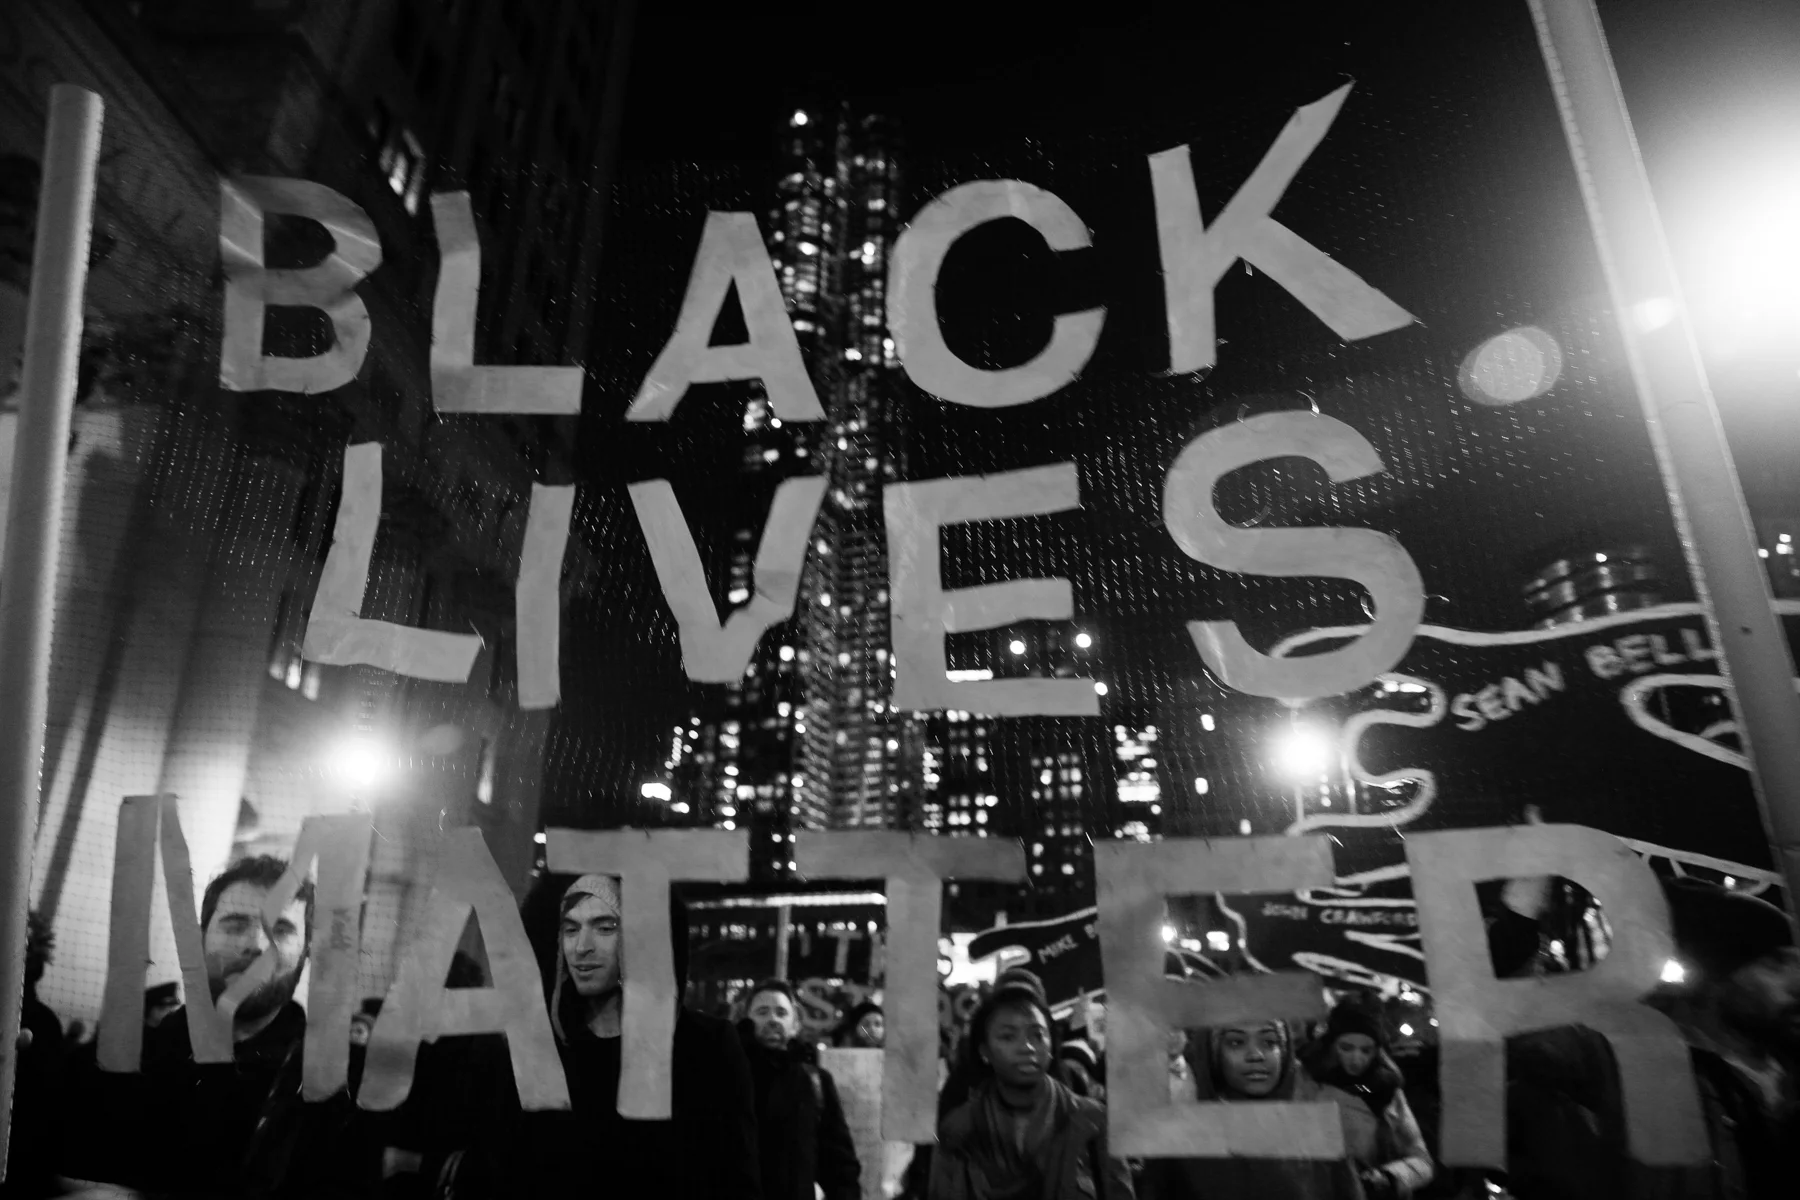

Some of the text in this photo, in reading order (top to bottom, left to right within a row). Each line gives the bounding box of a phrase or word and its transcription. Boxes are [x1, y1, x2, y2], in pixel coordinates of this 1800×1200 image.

[218, 81, 1415, 421] BLACK
[301, 409, 1426, 717] LIVES
[1450, 627, 1717, 732] SEAN BELL
[97, 792, 1712, 1168] MATTER
[1036, 933, 1080, 966] MIKE
